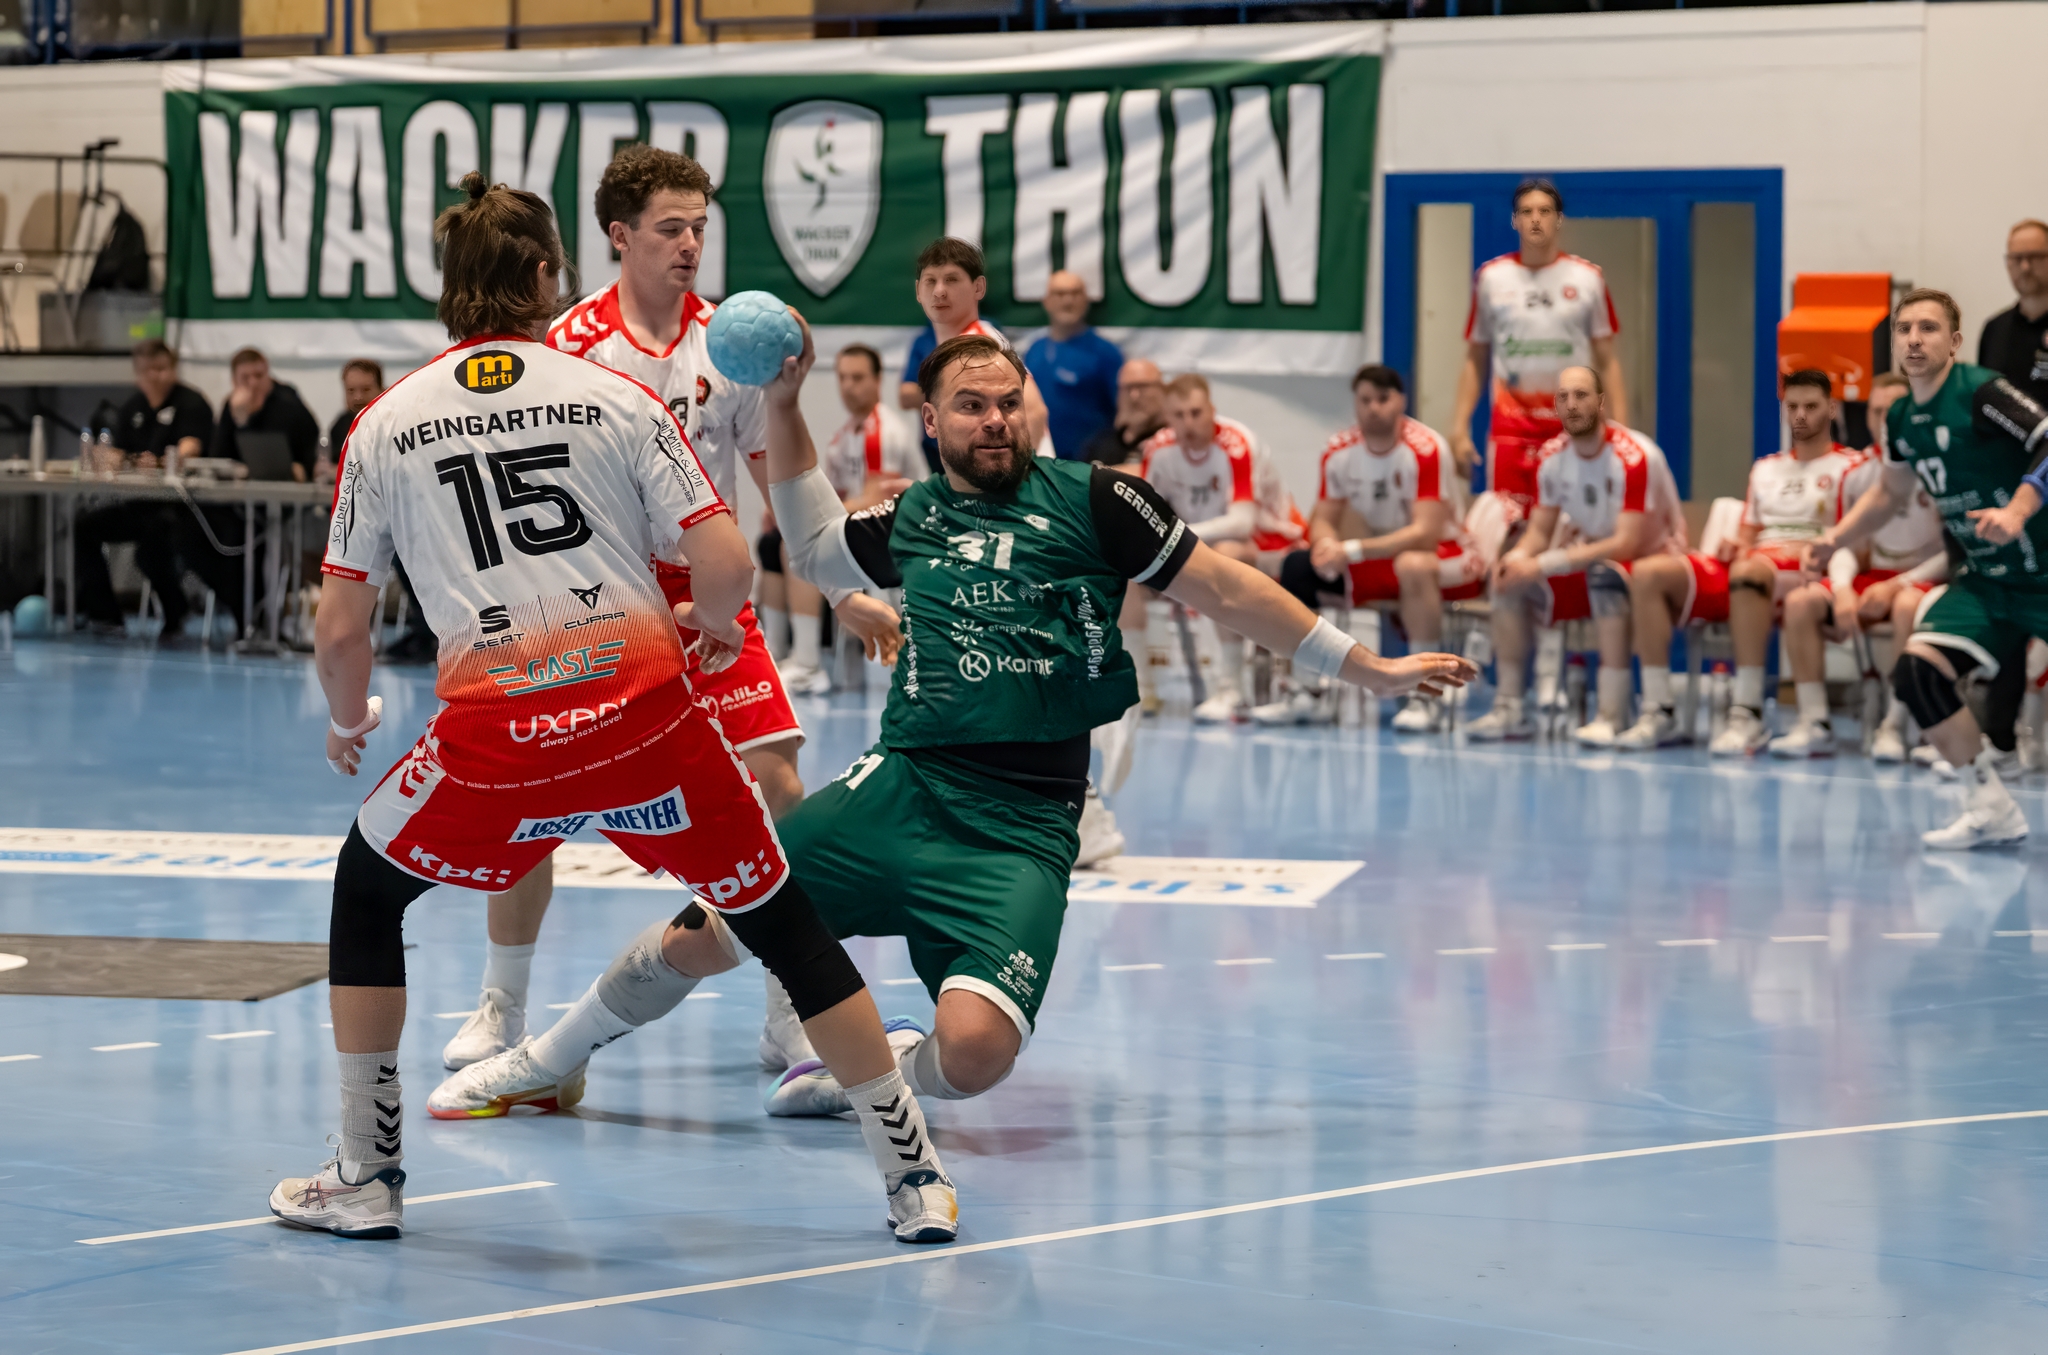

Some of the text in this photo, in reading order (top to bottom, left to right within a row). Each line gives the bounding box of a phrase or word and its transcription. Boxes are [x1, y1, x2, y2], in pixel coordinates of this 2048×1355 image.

[925, 83, 1325, 307] THUN
[393, 402, 603, 456] WEINGARTNER
[1915, 456, 1948, 495] 17
[434, 442, 594, 573] 15
[947, 530, 1015, 571] 31
[950, 579, 1016, 608] AEK
[564, 611, 626, 630] CUPRA
[473, 633, 525, 651] SEAT
[526, 646, 593, 685] GAST
[540, 734, 575, 749] always
[600, 711, 624, 730] level
[601, 796, 682, 831] MEYER
[1008, 953, 1039, 980] PROBST
